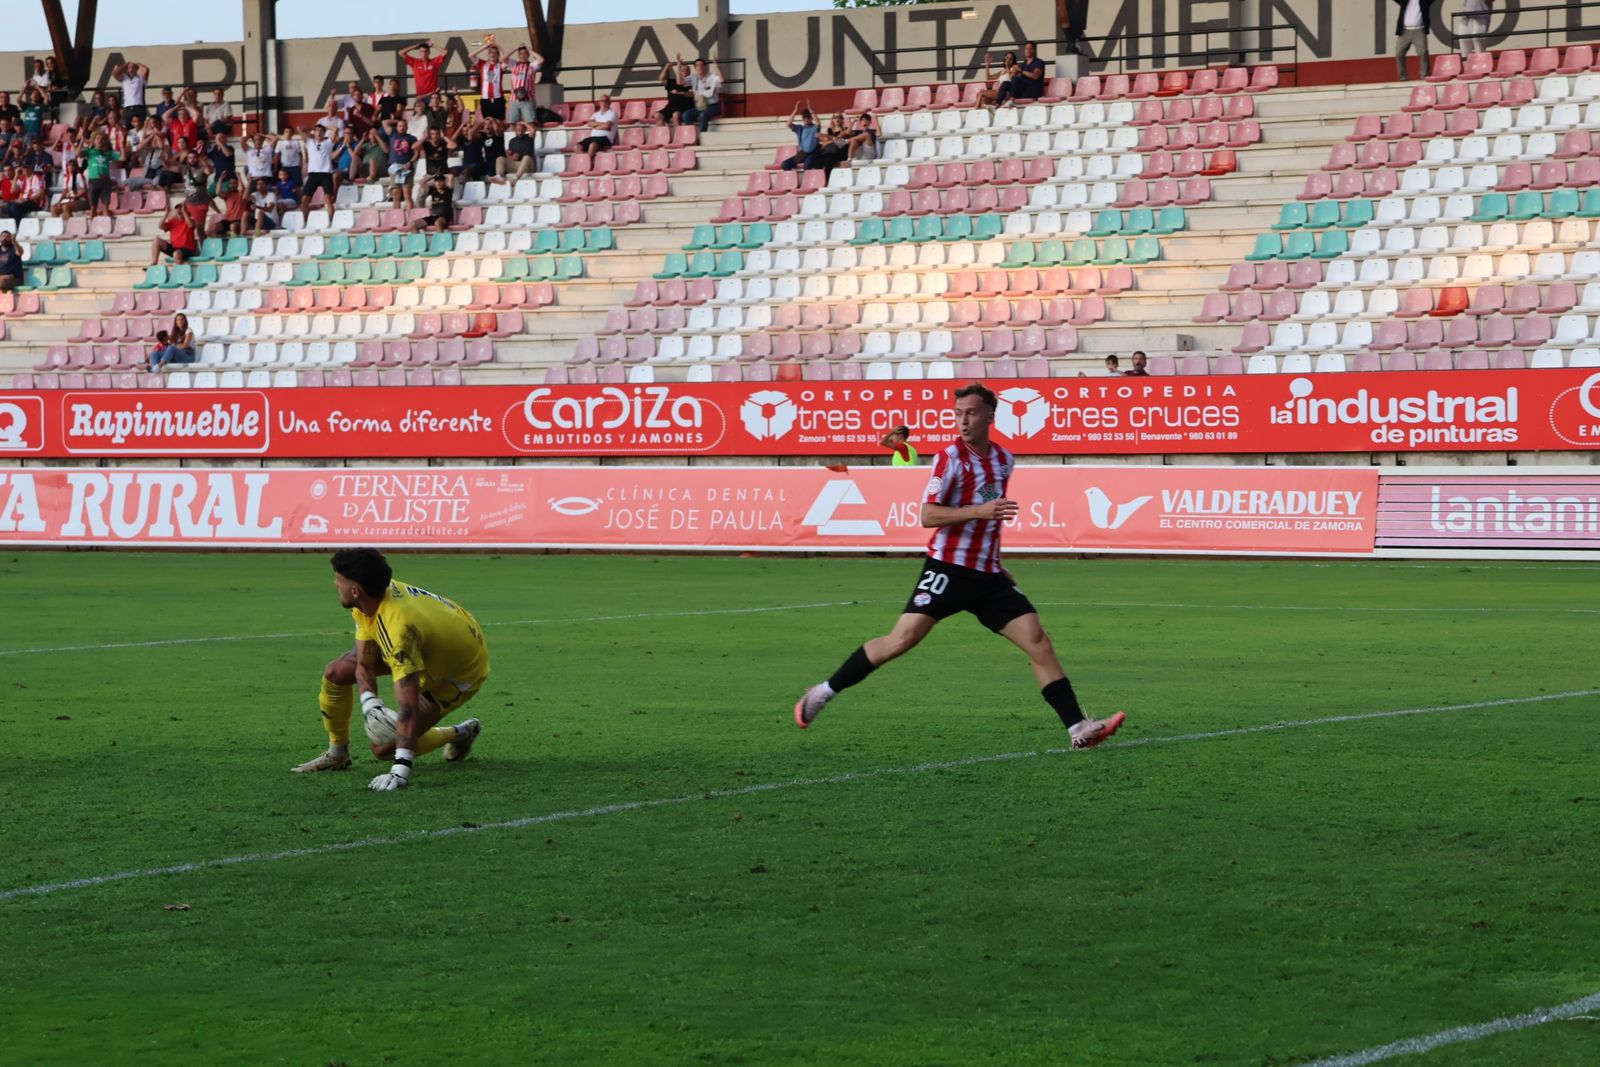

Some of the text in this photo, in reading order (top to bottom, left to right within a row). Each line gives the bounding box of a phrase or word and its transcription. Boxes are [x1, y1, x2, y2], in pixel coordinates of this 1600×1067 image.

[801, 389, 948, 402] ORTOPEDI
[1054, 385, 1236, 399] ORTOPEDIA
[1051, 404, 1240, 428] tres cruces
[1271, 387, 1518, 424] la industrial
[69, 402, 259, 443] Rapimueble
[279, 409, 492, 433] Una forma diferente
[798, 406, 956, 430] tres cruce
[524, 433, 703, 444] EMBUTIDOS Y JAMONES
[1052, 433, 1081, 441] Zamora
[1088, 433, 1101, 441] 980
[1140, 432, 1182, 440] Benavente
[1189, 432, 1203, 440] 980
[1205, 432, 1214, 440] 63
[1216, 432, 1226, 440] 01
[1227, 431, 1237, 440] 89
[1371, 423, 1518, 447] de pinturas
[333, 474, 469, 496] TERNERA
[607, 485, 786, 501] CLÍNICA DENTAL
[0, 473, 282, 538] A RURAL
[1161, 490, 1362, 515] VALDERADUEY
[604, 504, 783, 530] JOSÉ DE PAULA
[1160, 519, 1363, 531] EL CENTRO COMERCIAL DE ZAMORA
[917, 570, 949, 595] 20
